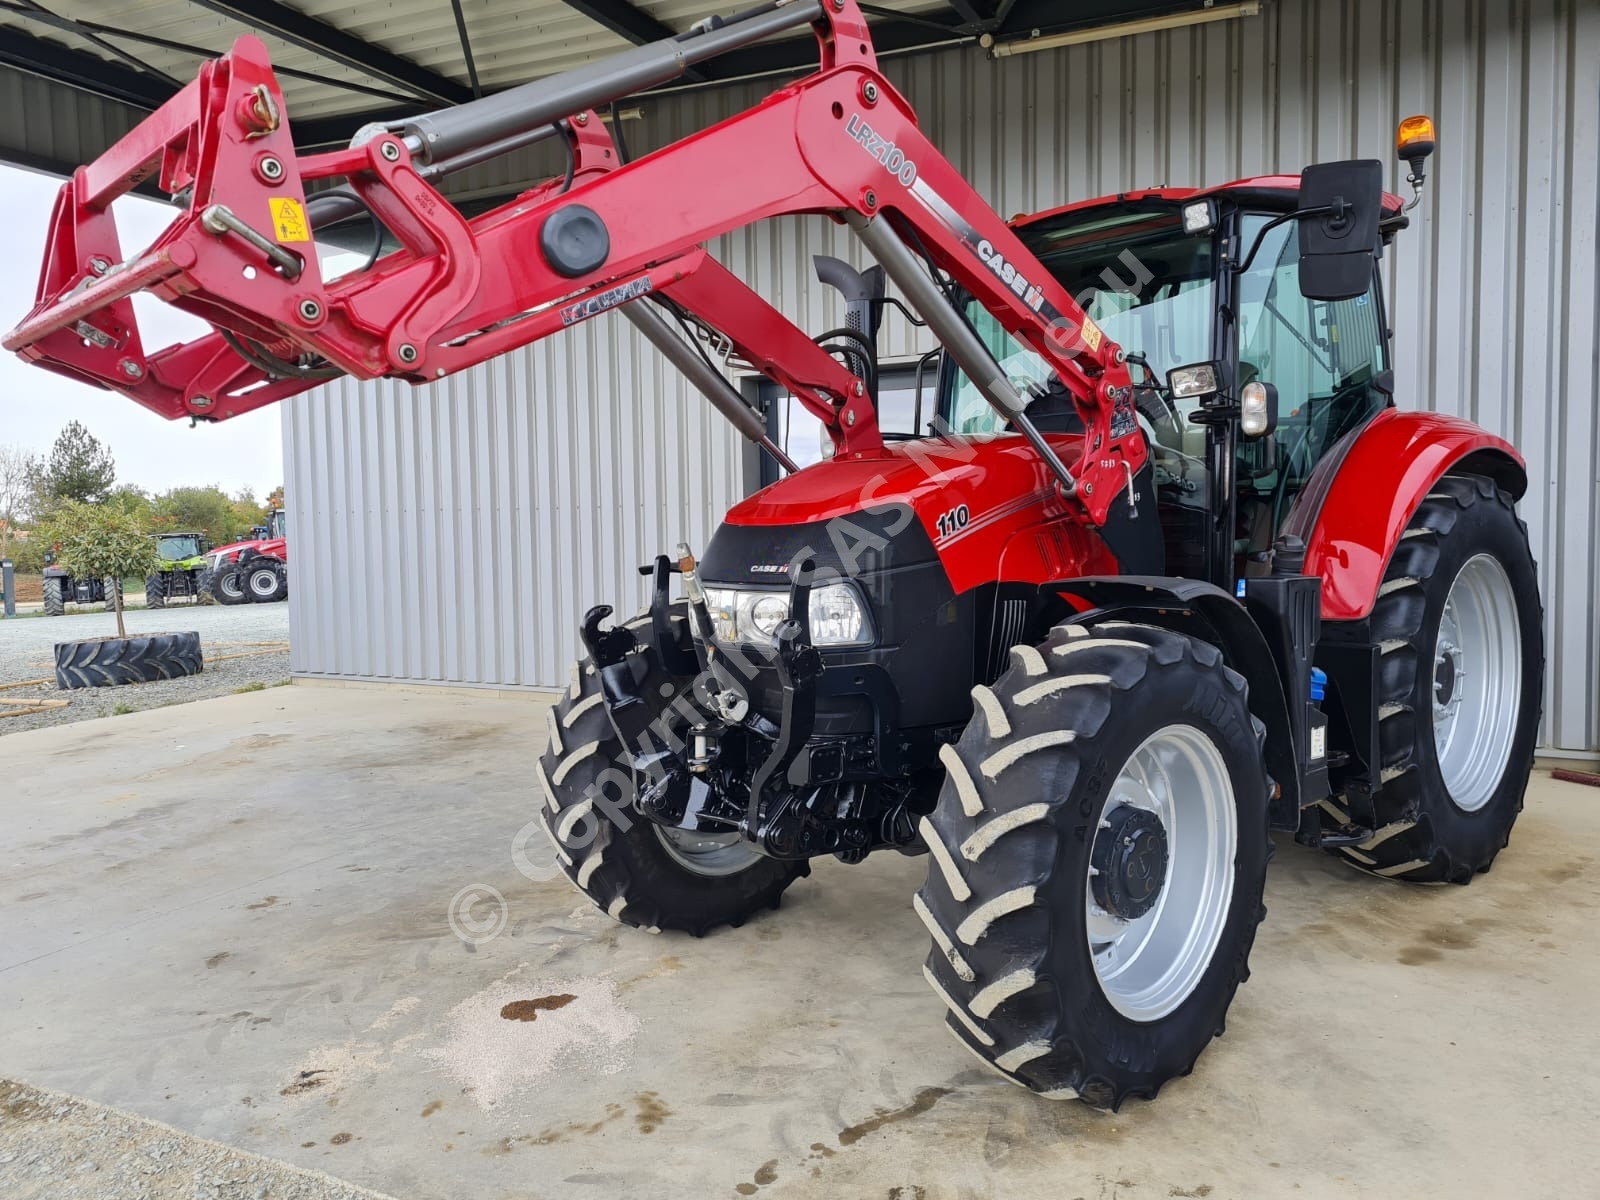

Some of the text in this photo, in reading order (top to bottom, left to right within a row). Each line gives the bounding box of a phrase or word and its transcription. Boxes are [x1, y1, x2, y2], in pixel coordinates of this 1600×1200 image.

[845, 113, 917, 187] LRZ100
[977, 239, 1028, 297] CASE
[936, 504, 970, 539] 110
[750, 565, 778, 573] CASE
